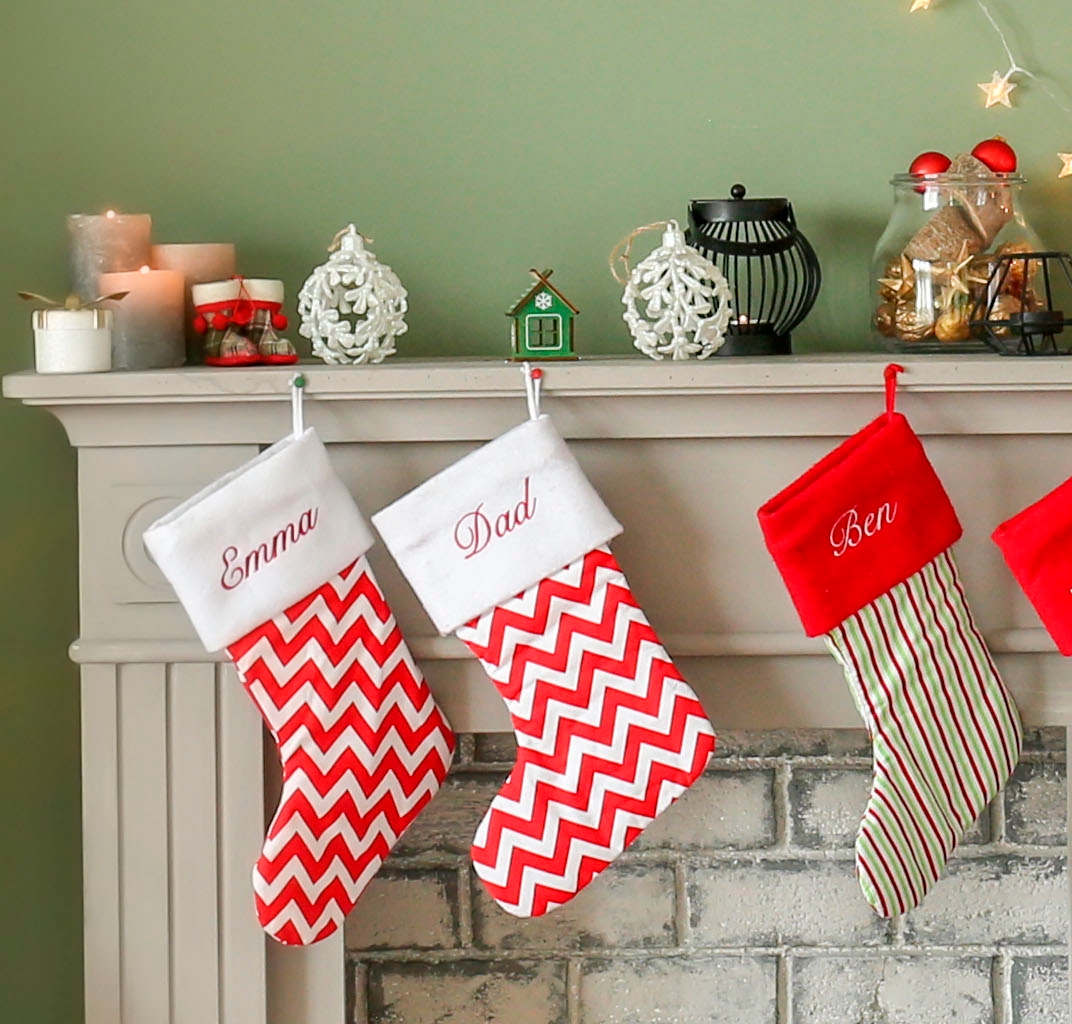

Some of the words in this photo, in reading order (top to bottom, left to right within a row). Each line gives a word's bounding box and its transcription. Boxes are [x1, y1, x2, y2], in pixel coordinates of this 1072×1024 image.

[219, 506, 319, 591] Emma
[453, 476, 537, 560] Dad
[829, 500, 898, 557] Ben
